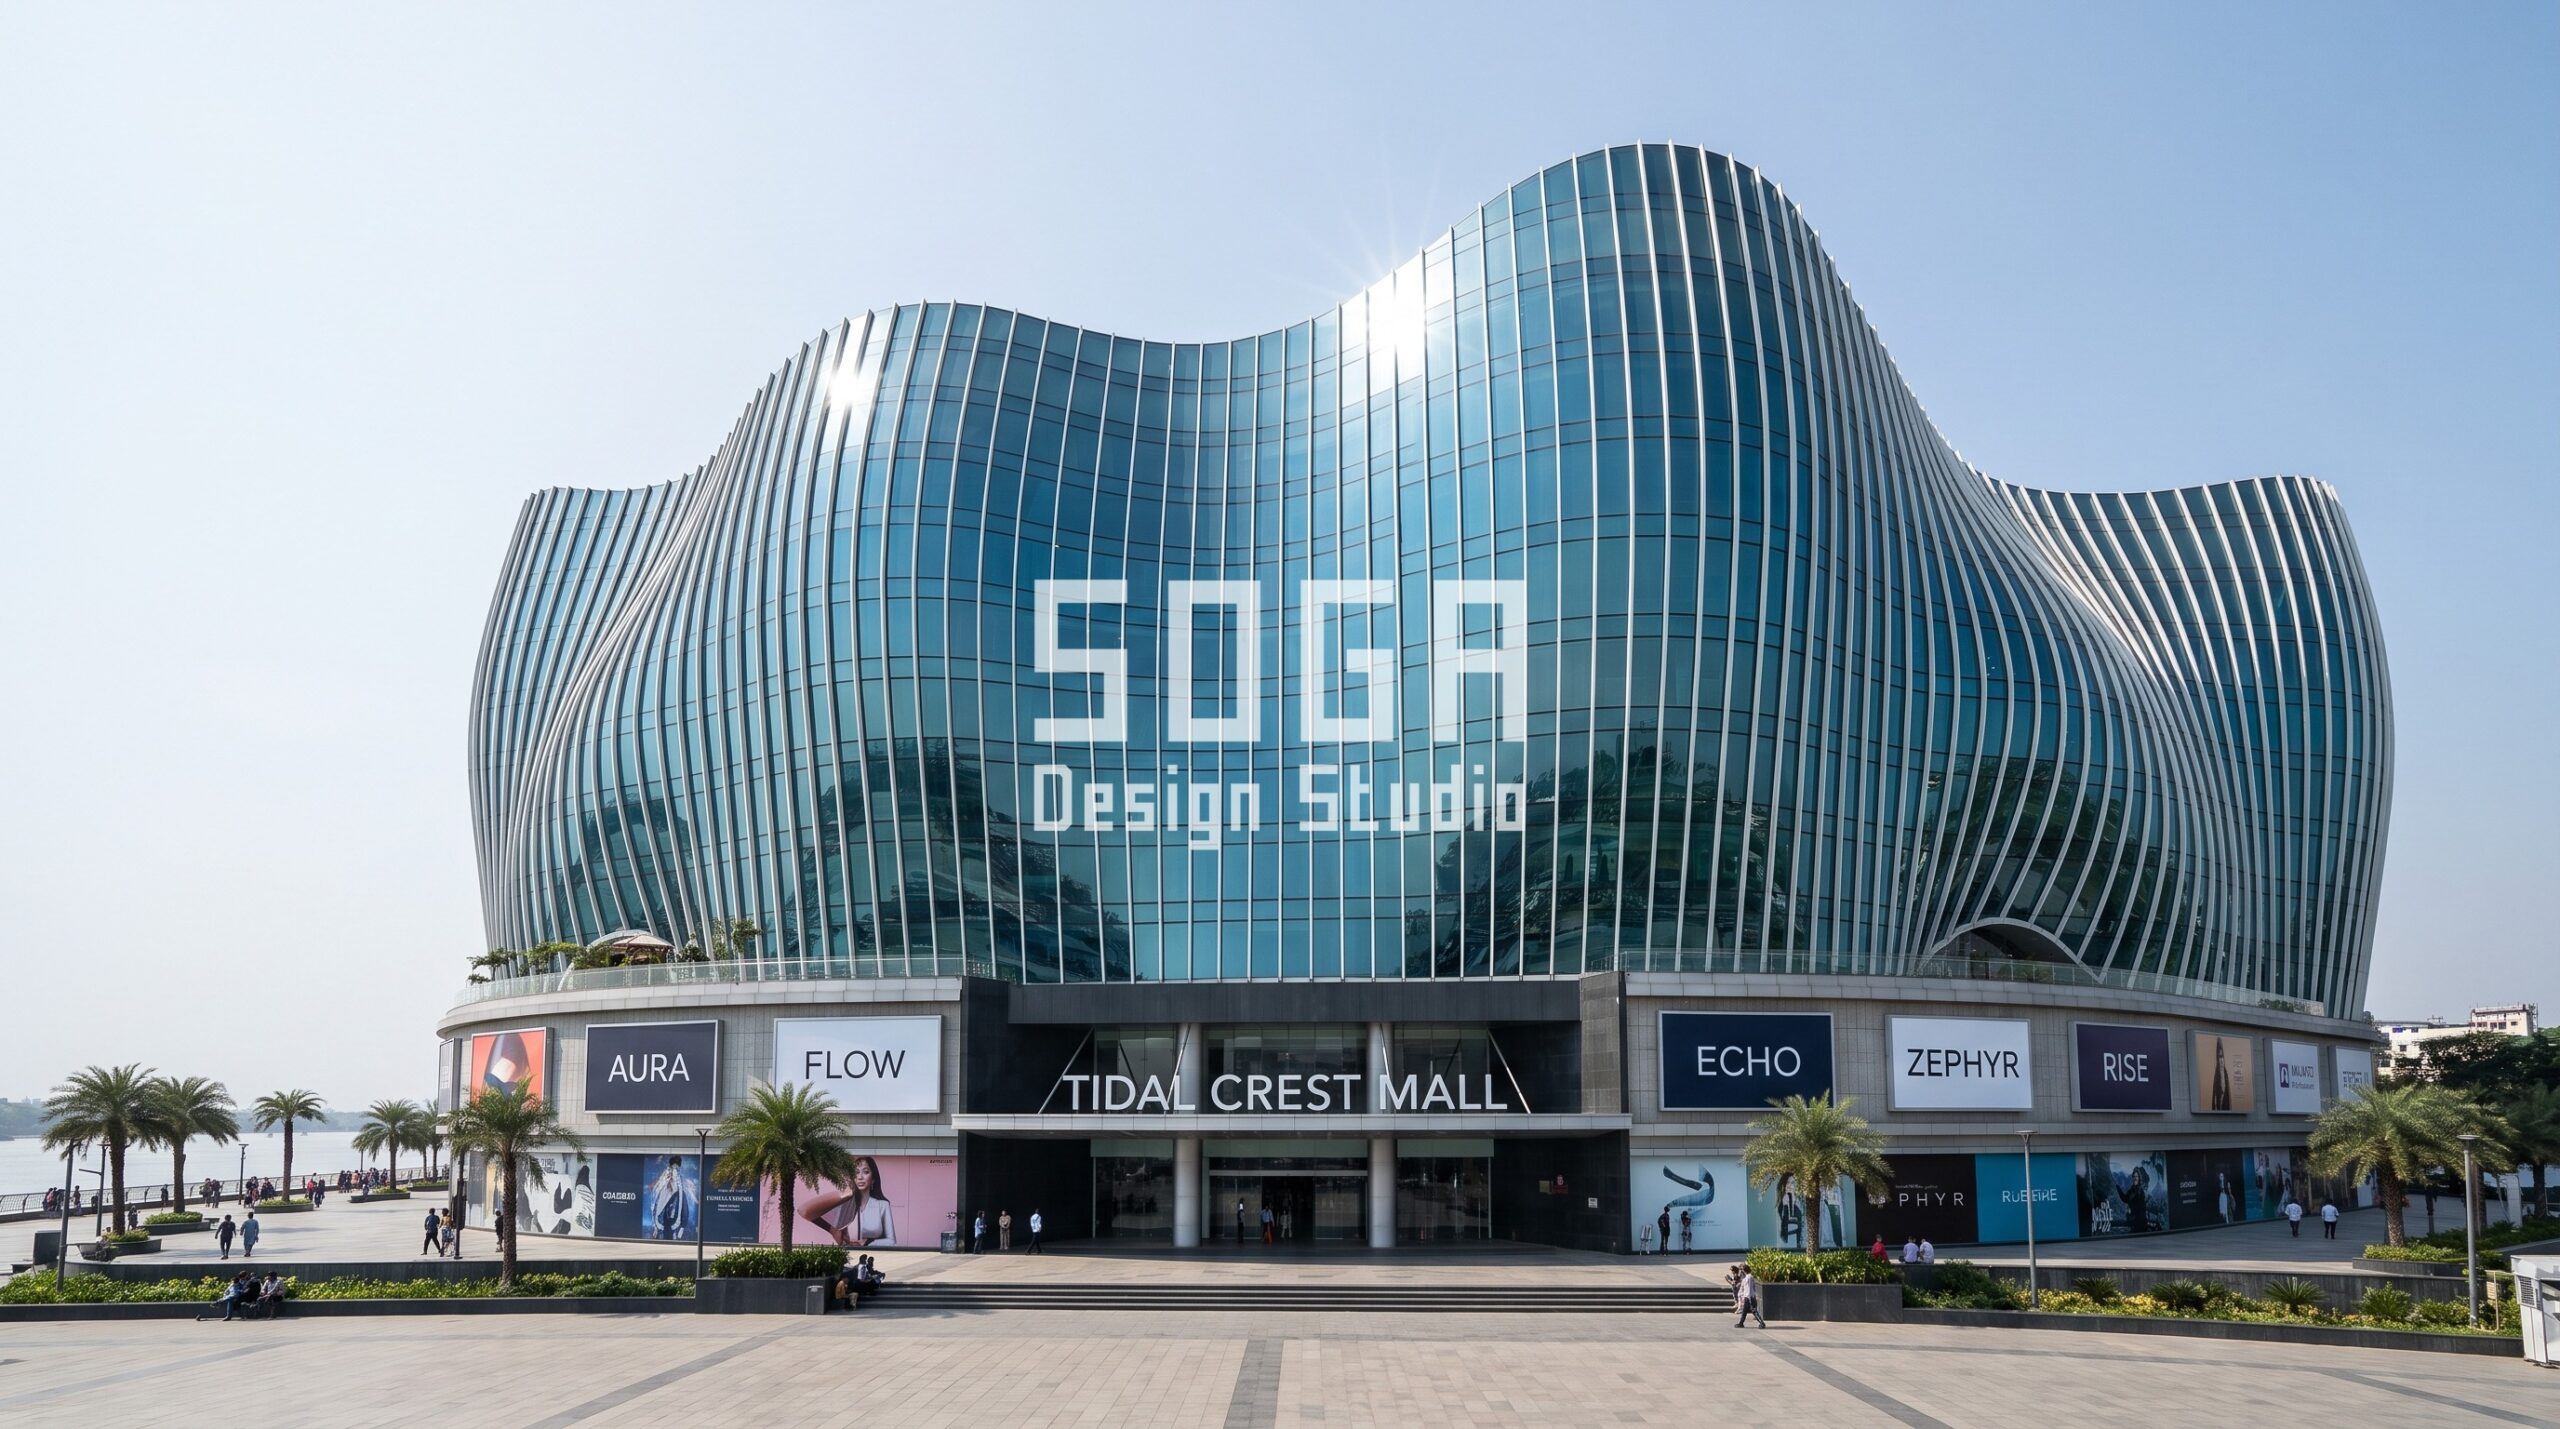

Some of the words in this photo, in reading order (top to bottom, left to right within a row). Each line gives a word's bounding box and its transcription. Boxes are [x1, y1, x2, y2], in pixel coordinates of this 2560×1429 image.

[608, 1053, 690, 1083] AURA
[805, 1049, 906, 1079] FLOW
[1697, 1045, 1801, 1077] ECHO
[1907, 1048, 2020, 1079] ZEPHYR
[2103, 1052, 2149, 1083] RISE
[1062, 1074, 1196, 1111] TIDAL
[1211, 1073, 1361, 1111] CREST
[1379, 1073, 1508, 1110] MALL
